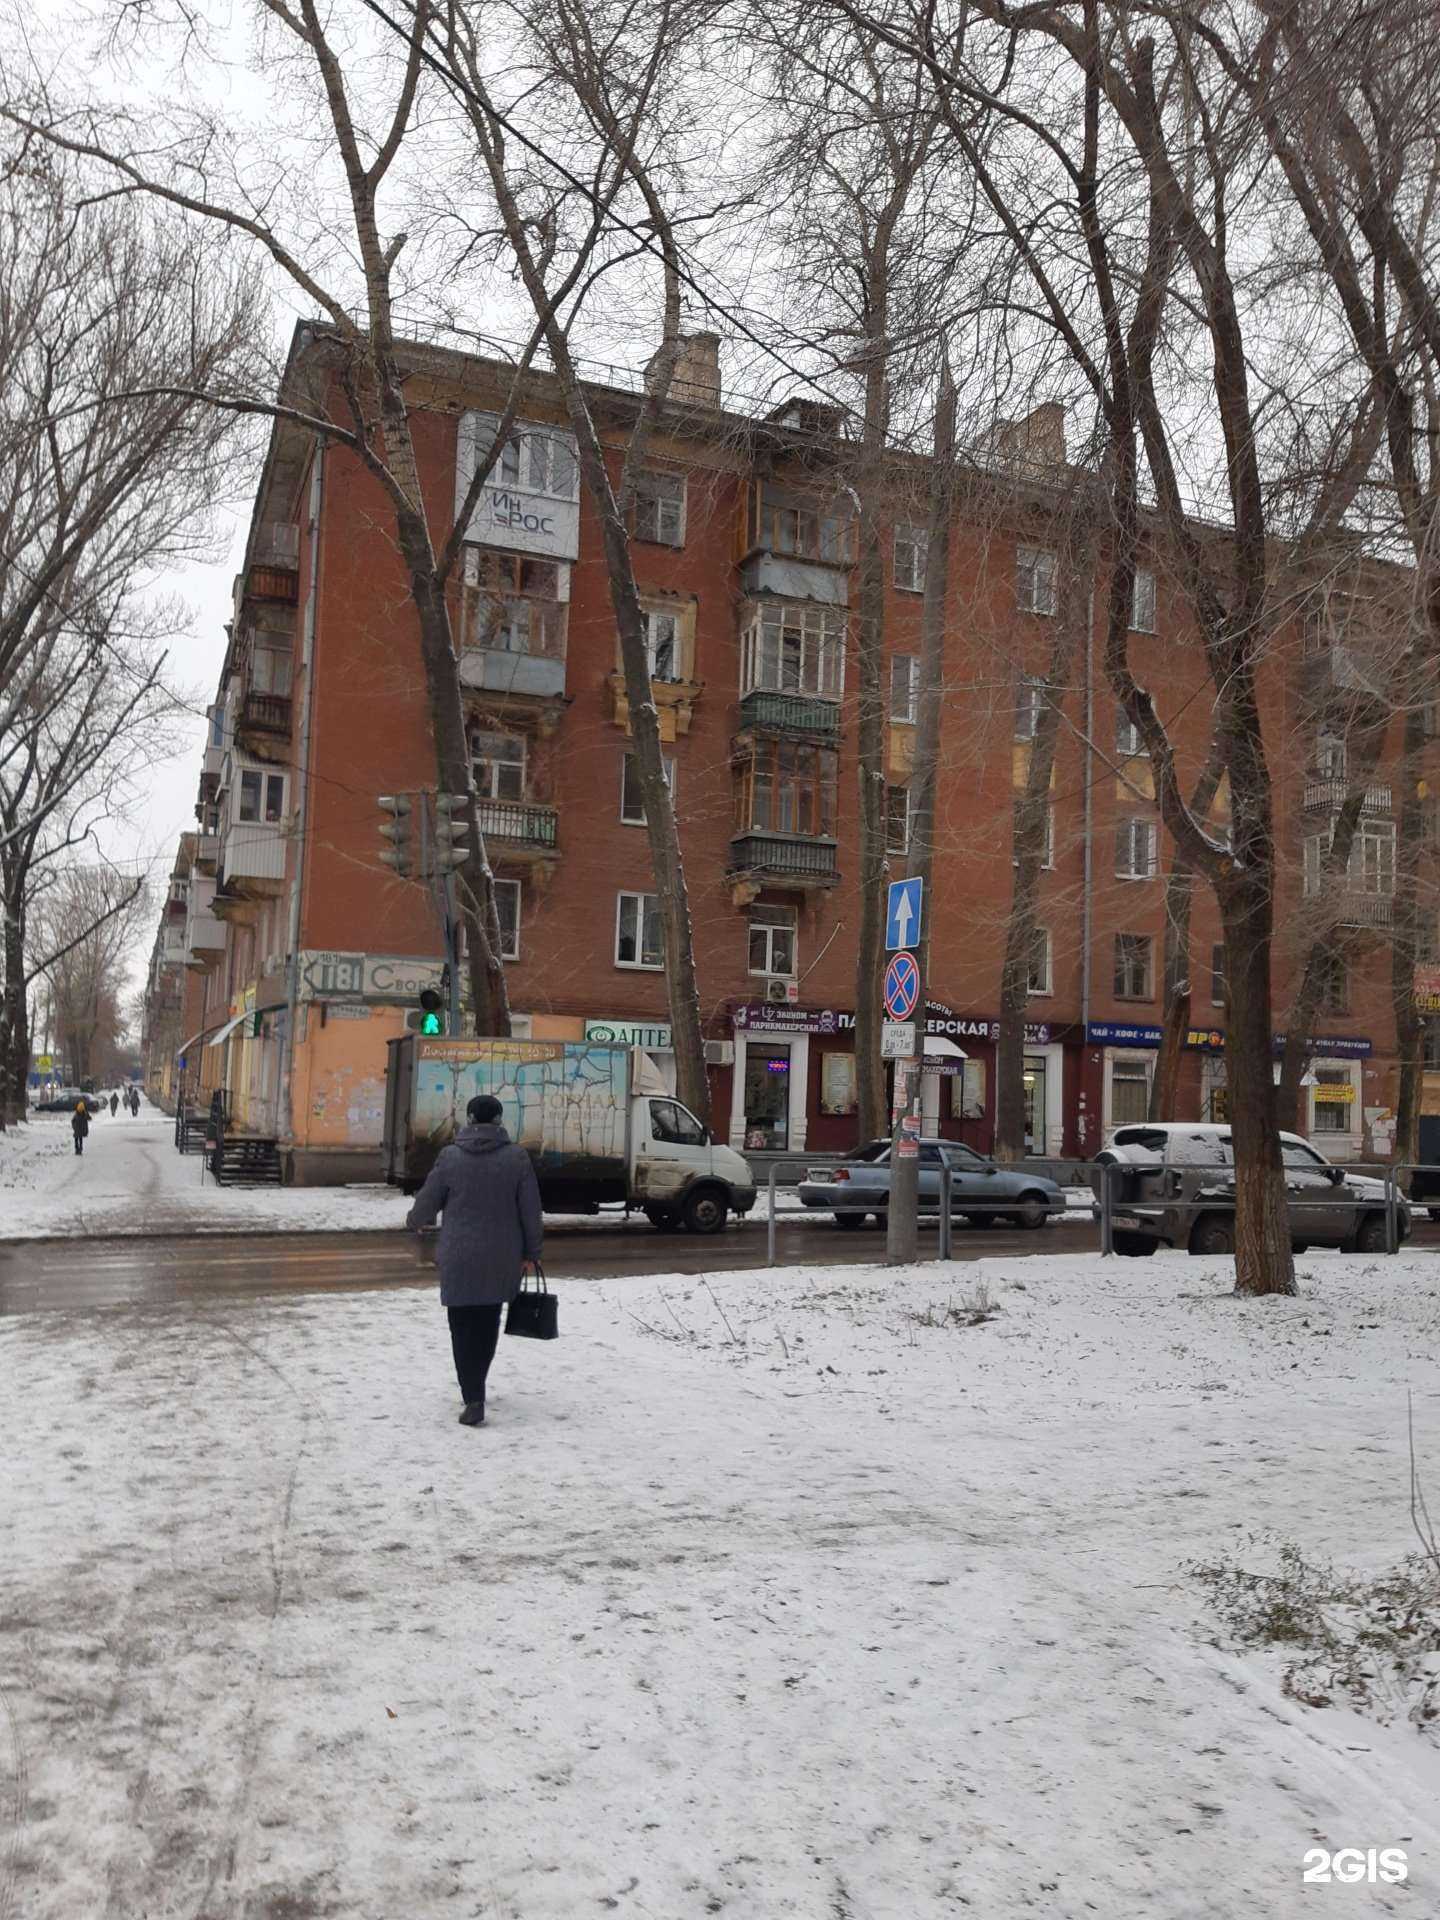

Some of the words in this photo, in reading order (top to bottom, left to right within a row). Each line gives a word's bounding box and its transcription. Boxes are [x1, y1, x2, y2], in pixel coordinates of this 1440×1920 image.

[750, 1020, 819, 1032] ПАРИКМАХЕРСКАЯ
[619, 1027, 673, 1048] АПТЕ
[1091, 1027, 1108, 1037] ЧАЙ
[1114, 1029, 1138, 1039] КОФЕ
[1144, 1032, 1163, 1041] БАК
